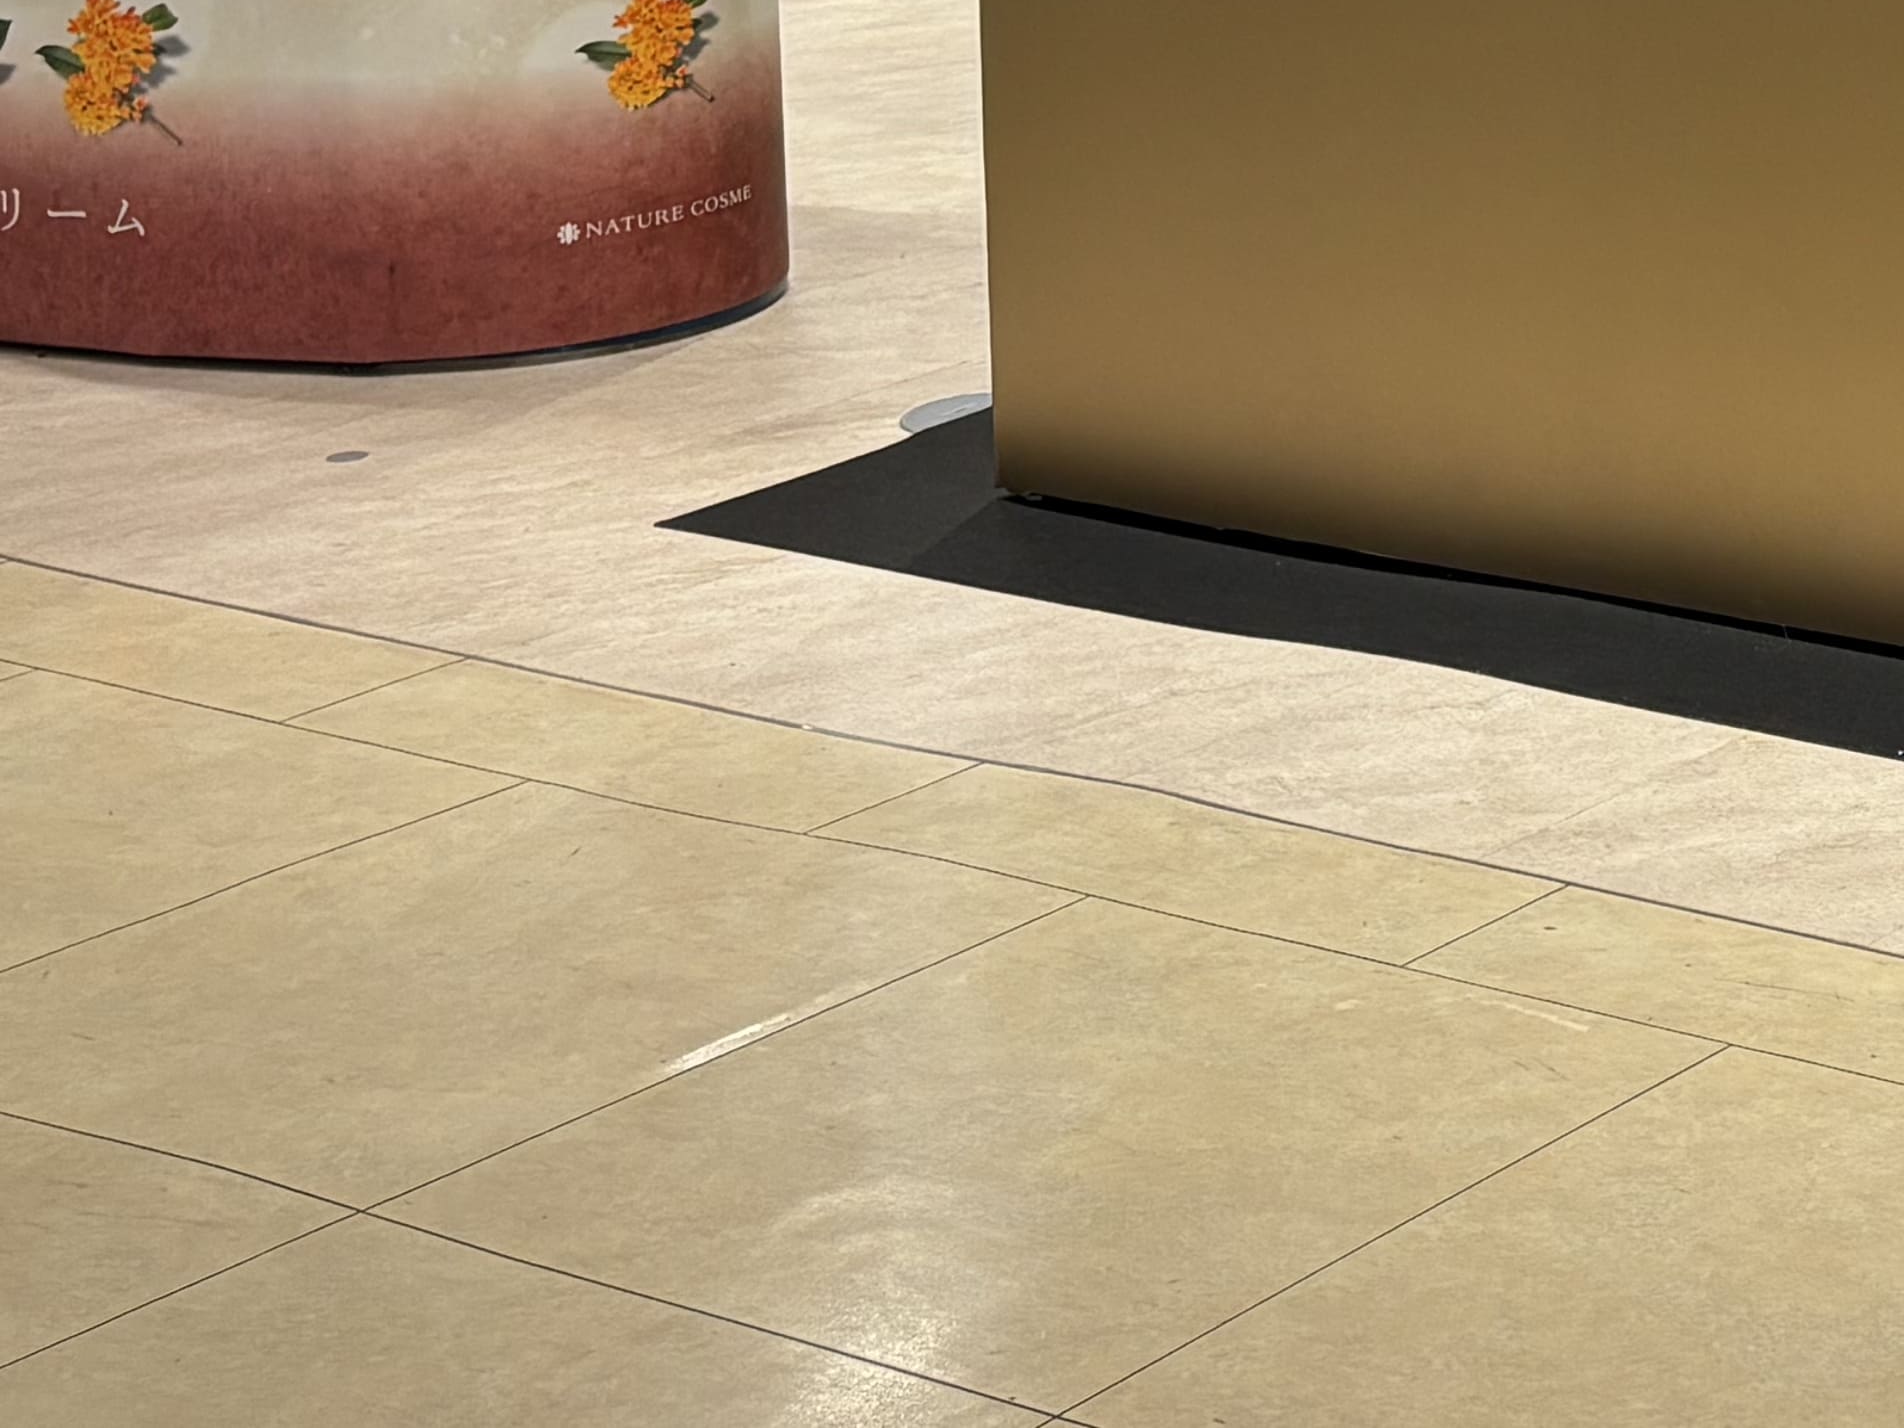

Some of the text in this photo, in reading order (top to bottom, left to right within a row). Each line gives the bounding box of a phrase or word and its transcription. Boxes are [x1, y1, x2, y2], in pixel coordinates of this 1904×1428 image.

[0, 186, 146, 239] リーム
[585, 183, 753, 239] NATURE COSME
